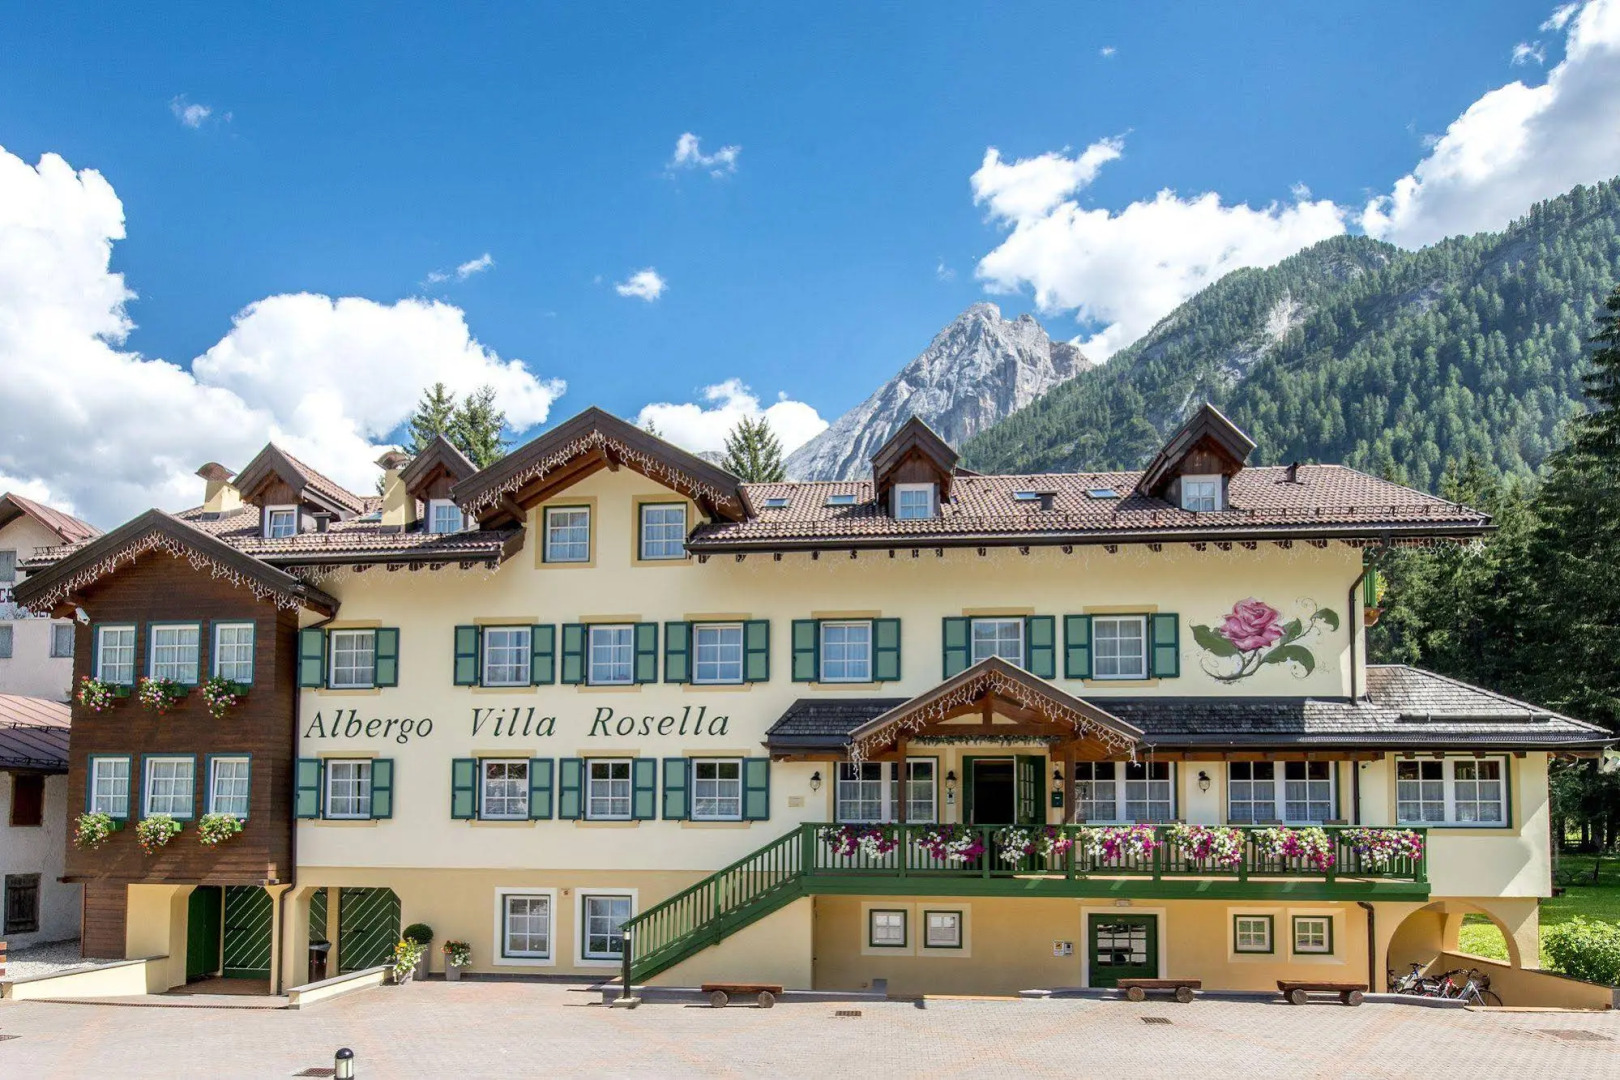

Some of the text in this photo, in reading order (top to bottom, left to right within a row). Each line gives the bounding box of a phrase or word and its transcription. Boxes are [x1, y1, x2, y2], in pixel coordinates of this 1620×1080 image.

[304, 706, 729, 744] Albergo Villa Rosella
